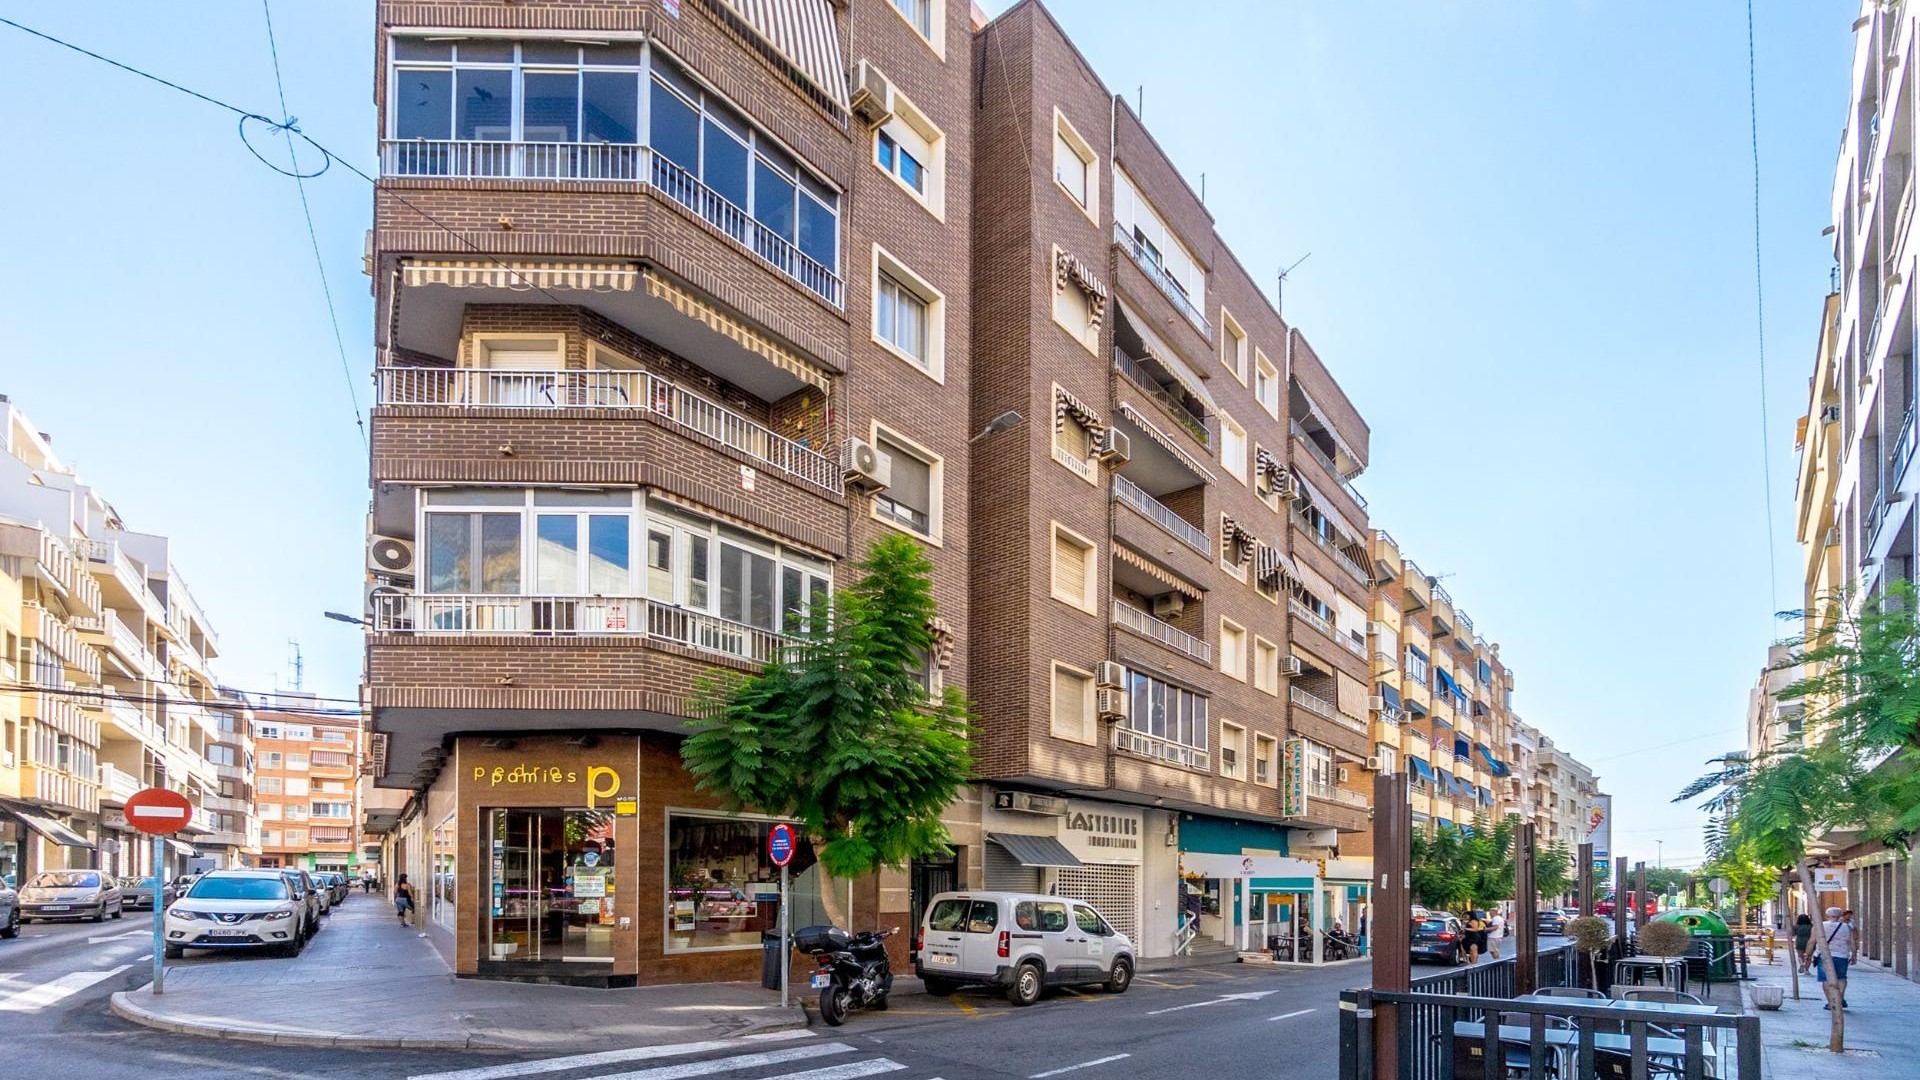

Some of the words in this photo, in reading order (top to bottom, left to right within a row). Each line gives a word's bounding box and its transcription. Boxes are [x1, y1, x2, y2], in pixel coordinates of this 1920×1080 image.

[474, 763, 561, 781] pedro
[491, 770, 577, 786] pamies
[587, 766, 621, 809] p
[1066, 811, 1137, 836] EASYGOING
